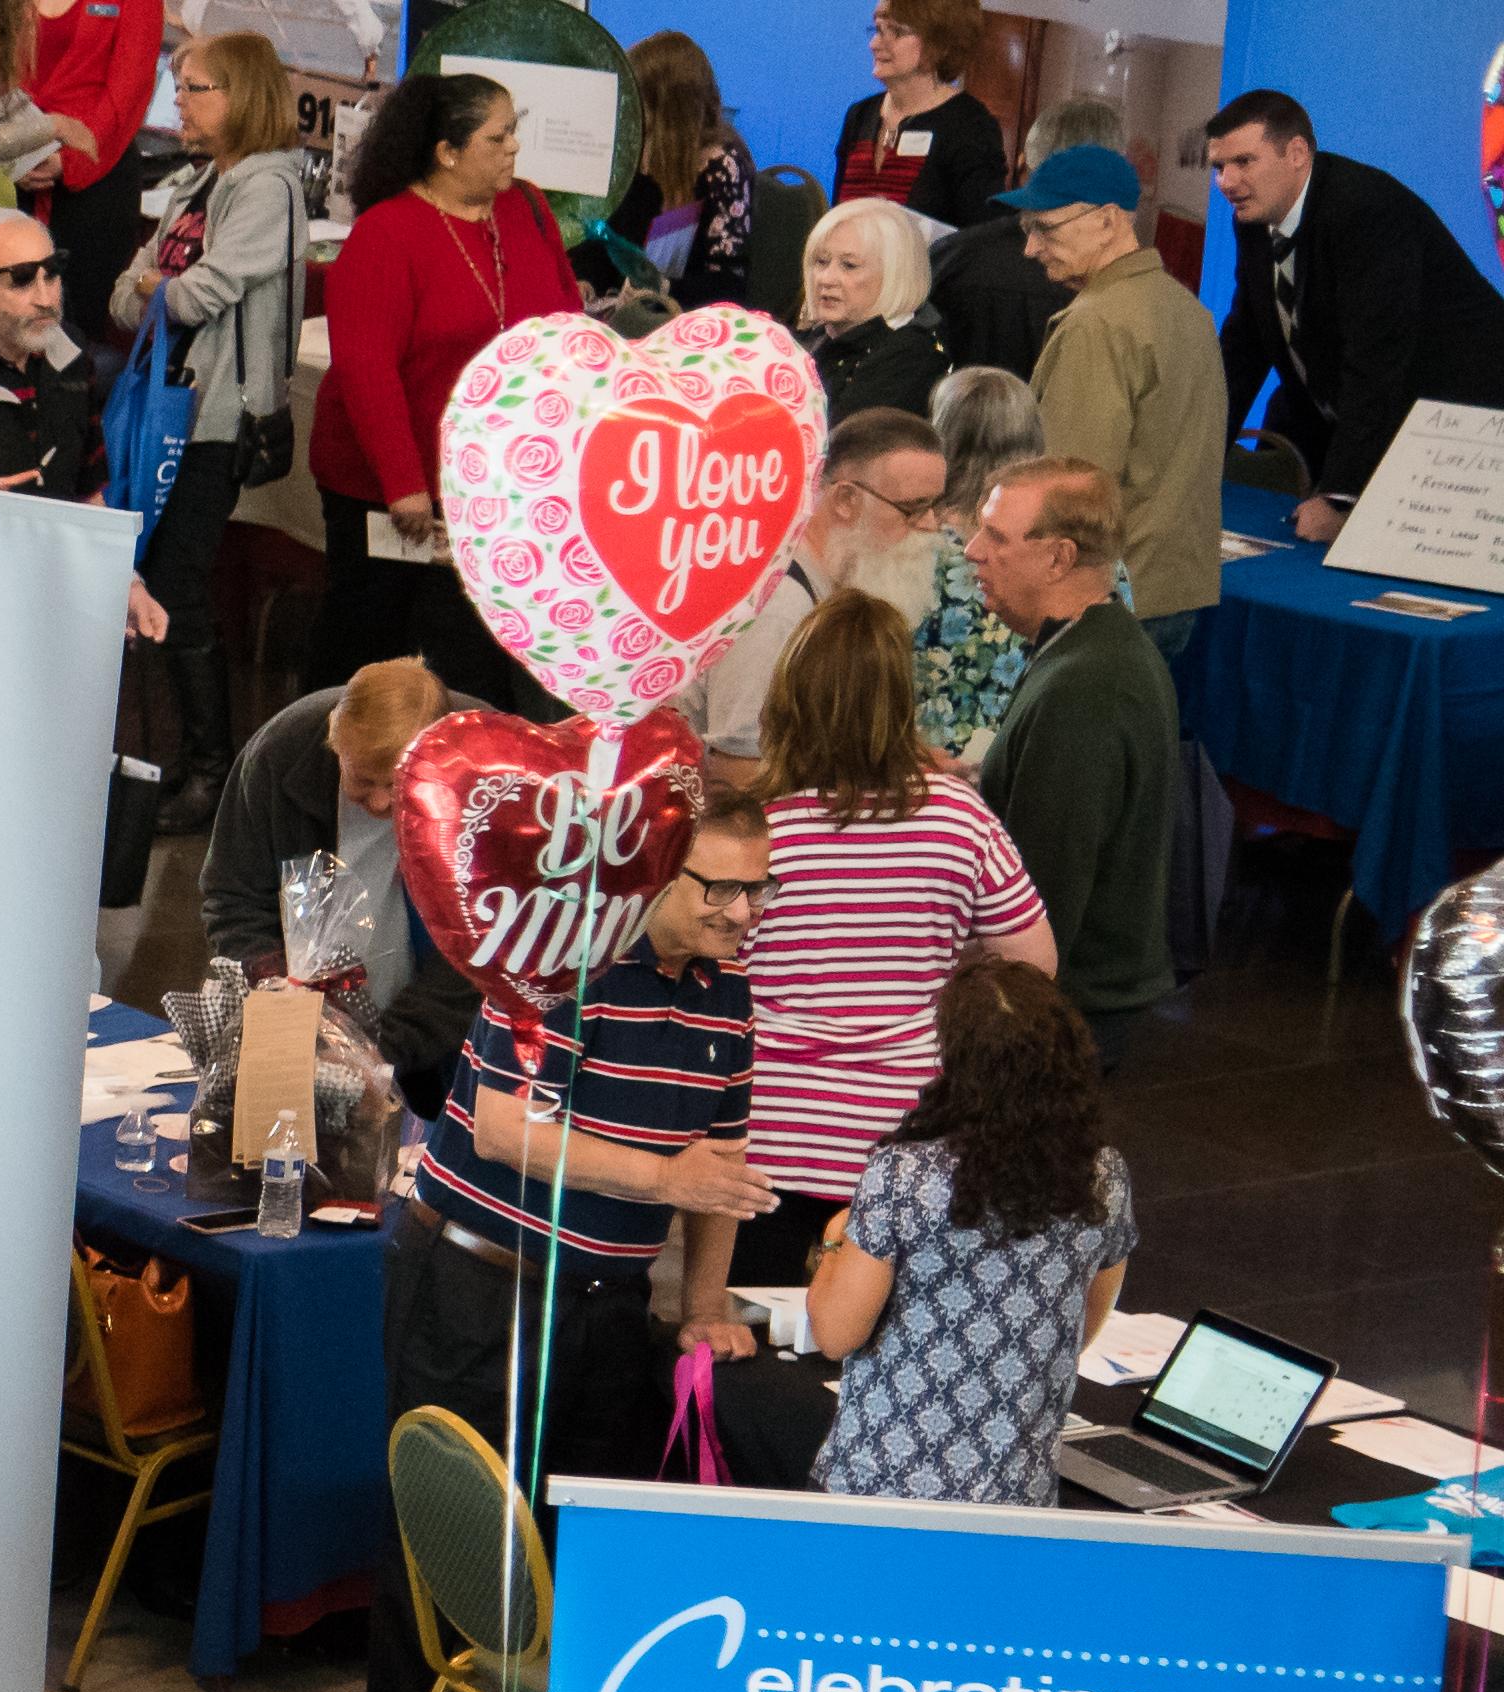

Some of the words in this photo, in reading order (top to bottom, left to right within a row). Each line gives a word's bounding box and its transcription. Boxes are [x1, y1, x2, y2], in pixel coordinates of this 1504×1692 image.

[674, 422, 787, 515] love
[658, 512, 765, 617] you
[535, 770, 652, 882] Be
